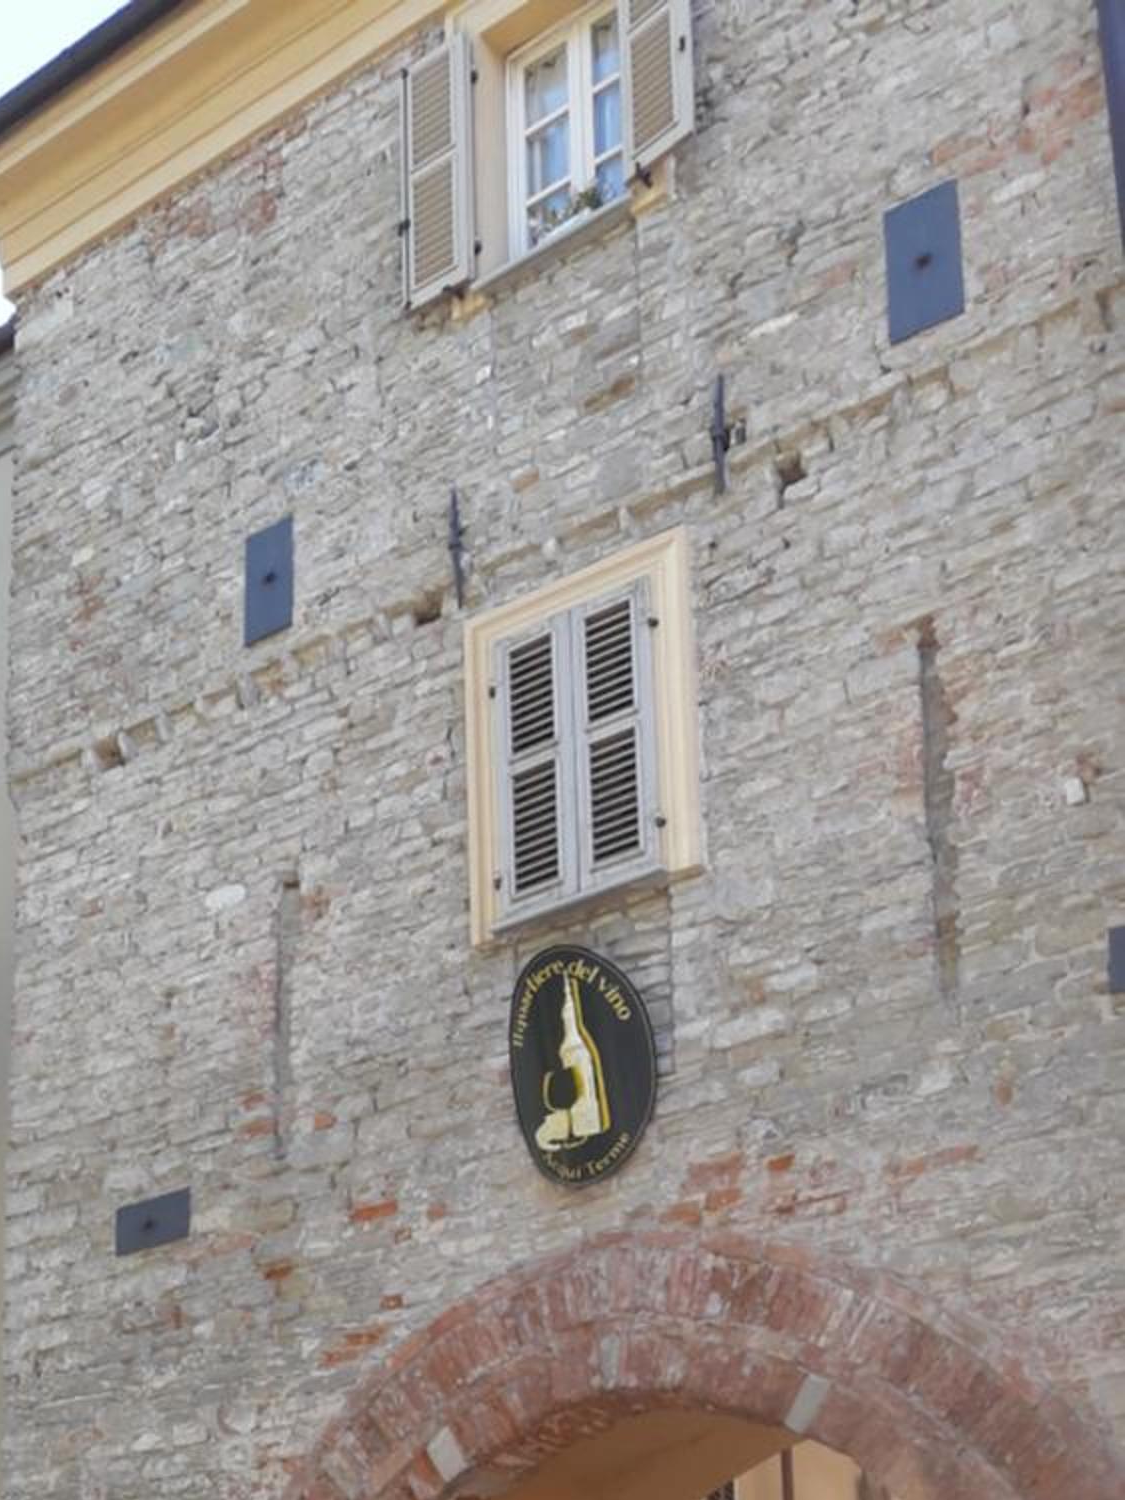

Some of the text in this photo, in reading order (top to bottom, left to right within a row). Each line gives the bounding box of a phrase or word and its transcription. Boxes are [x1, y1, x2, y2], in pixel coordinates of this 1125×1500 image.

[568, 959, 600, 984] del
[598, 976, 632, 1021] vino
[585, 1132, 631, 1176] Terme
